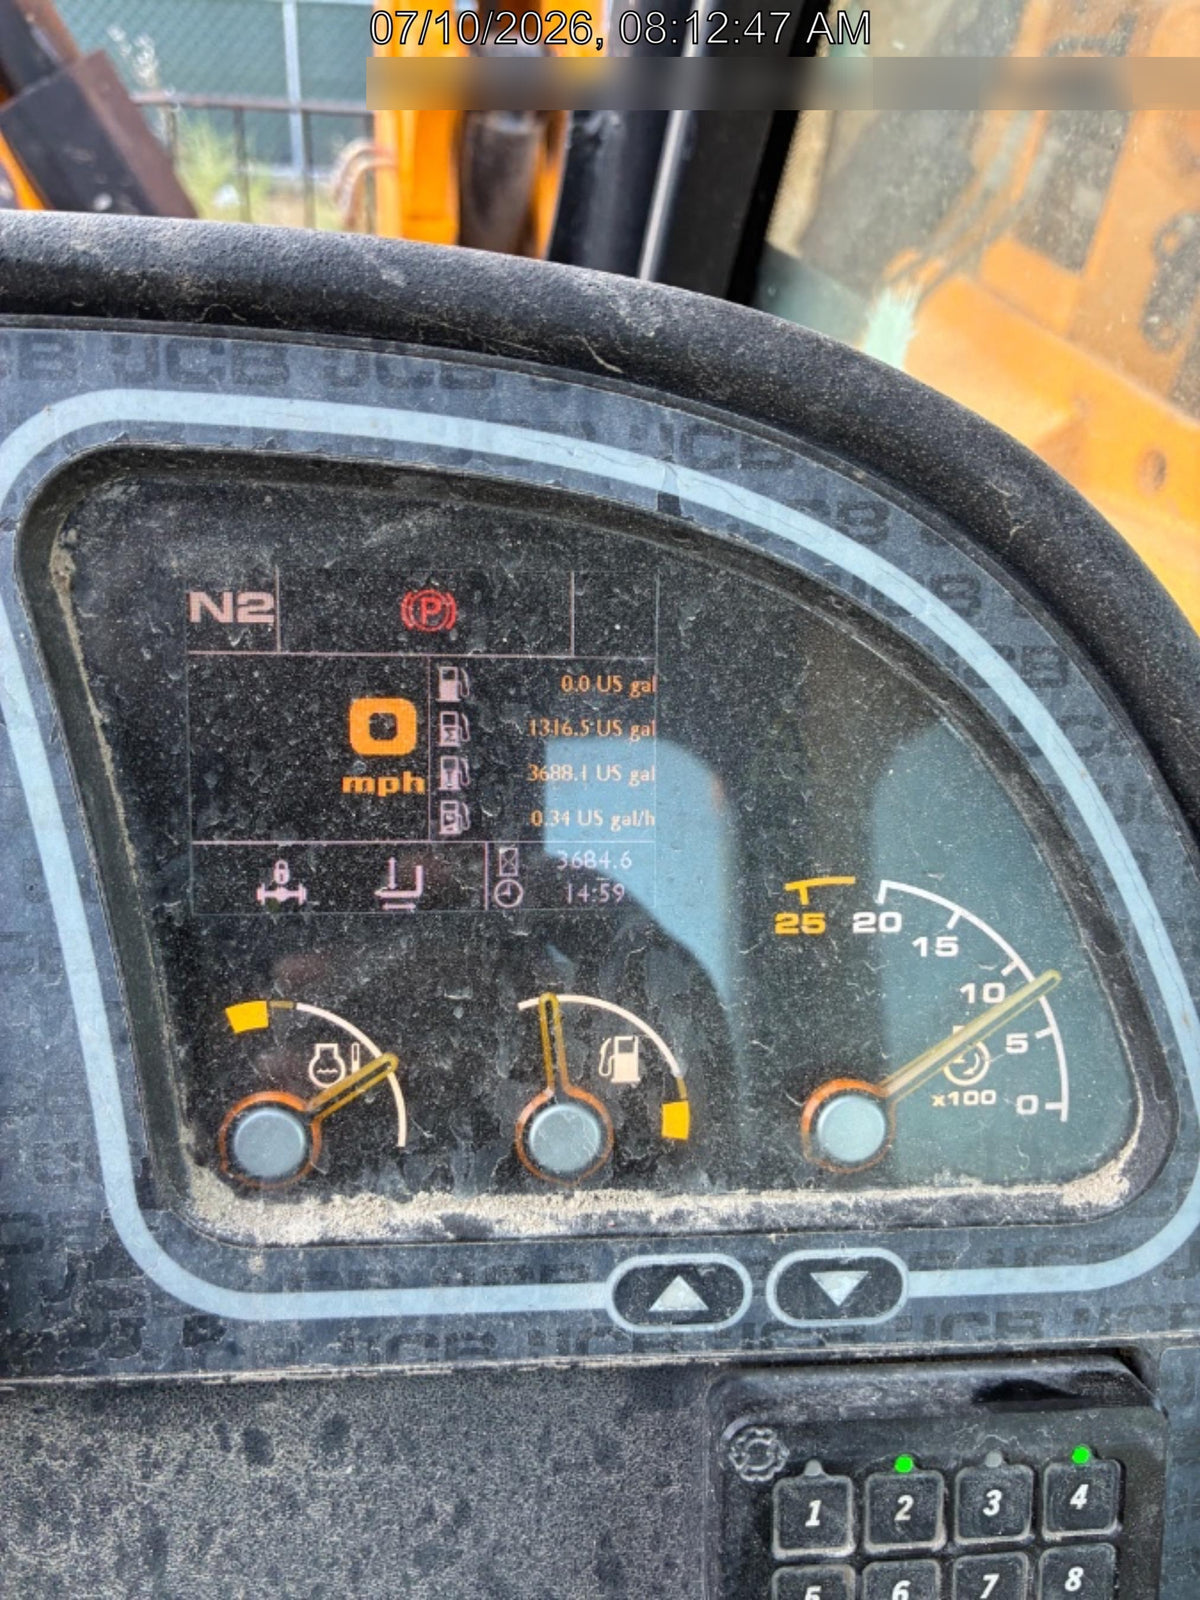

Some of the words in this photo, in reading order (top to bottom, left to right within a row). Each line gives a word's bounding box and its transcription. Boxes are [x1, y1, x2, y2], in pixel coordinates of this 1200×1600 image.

[189, 591, 275, 623] N2
[560, 674, 590, 693] 0.0
[597, 674, 623, 693] US
[629, 674, 657, 698] gal
[349, 697, 418, 756] 0
[529, 718, 590, 737] 1316.5
[597, 718, 623, 737] US
[629, 718, 656, 742] gal
[341, 771, 425, 797] mph
[527, 763, 588, 782] 3688.1
[597, 763, 622, 782] US
[628, 763, 656, 787] gal
[530, 809, 570, 827] 0.34
[577, 809, 603, 827] US
[610, 809, 656, 832] gal/h
[557, 850, 632, 869] 3684.6
[567, 882, 625, 903] 14:59
[774, 912, 827, 934] 25
[852, 911, 902, 933] 20
[912, 936, 959, 957] 15
[960, 982, 1006, 1003] 10
[1005, 1033, 1029, 1054] 5
[932, 1089, 997, 1107] x100
[1016, 1094, 1039, 1115] 0
[894, 1495, 913, 1522] 2
[983, 1489, 1002, 1517] 3
[1069, 1483, 1088, 1511] 4
[804, 1500, 822, 1528] 1
[891, 1580, 911, 1600] 6
[980, 1574, 998, 1600] 7
[1064, 1567, 1083, 1592] 8
